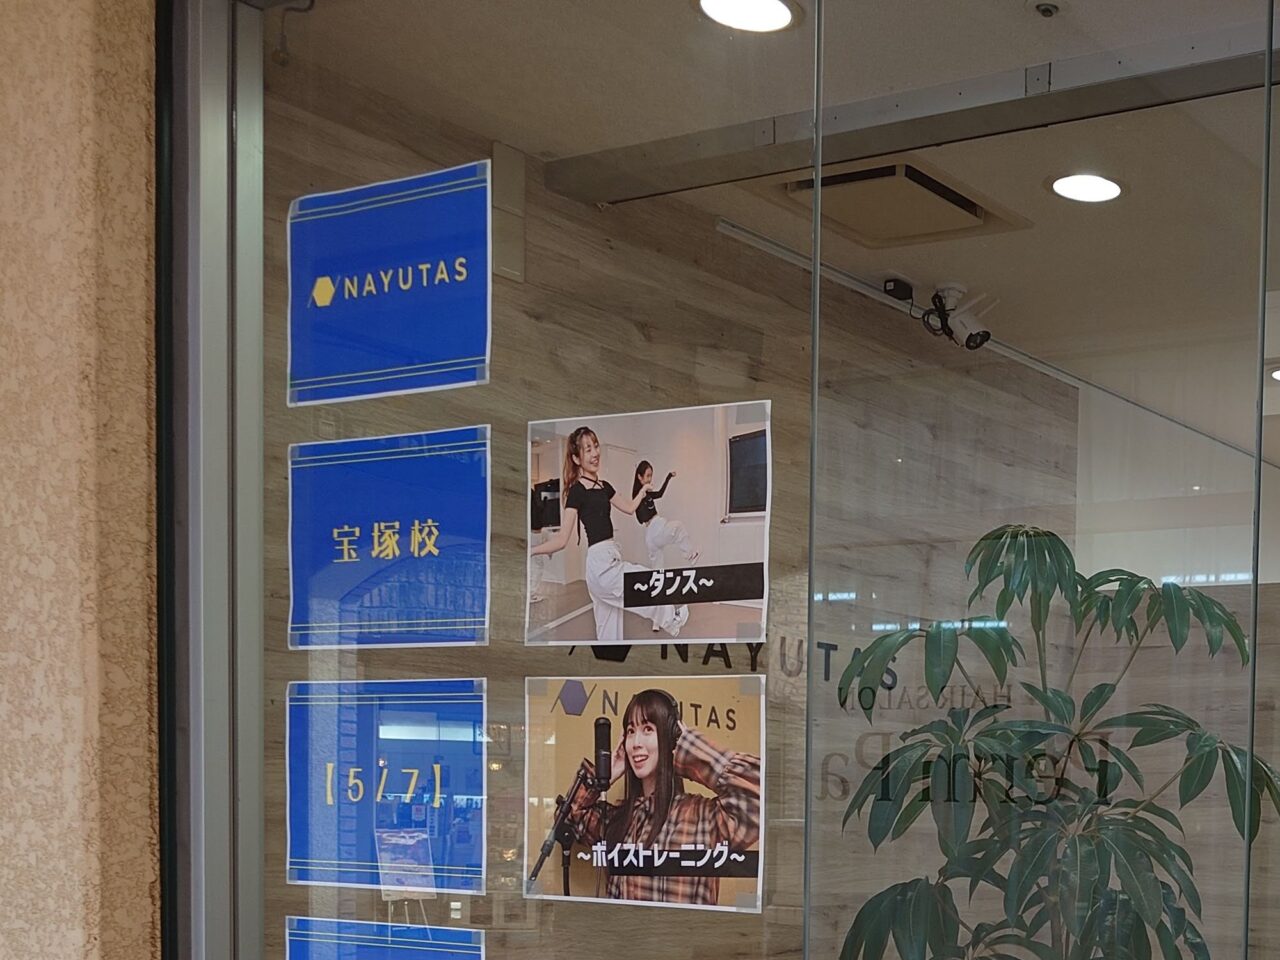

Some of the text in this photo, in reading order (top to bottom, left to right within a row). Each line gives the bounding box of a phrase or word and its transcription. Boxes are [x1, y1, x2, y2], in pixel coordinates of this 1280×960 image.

[343, 256, 468, 300] NAYUTAS
[332, 518, 441, 564] 宝塚校
